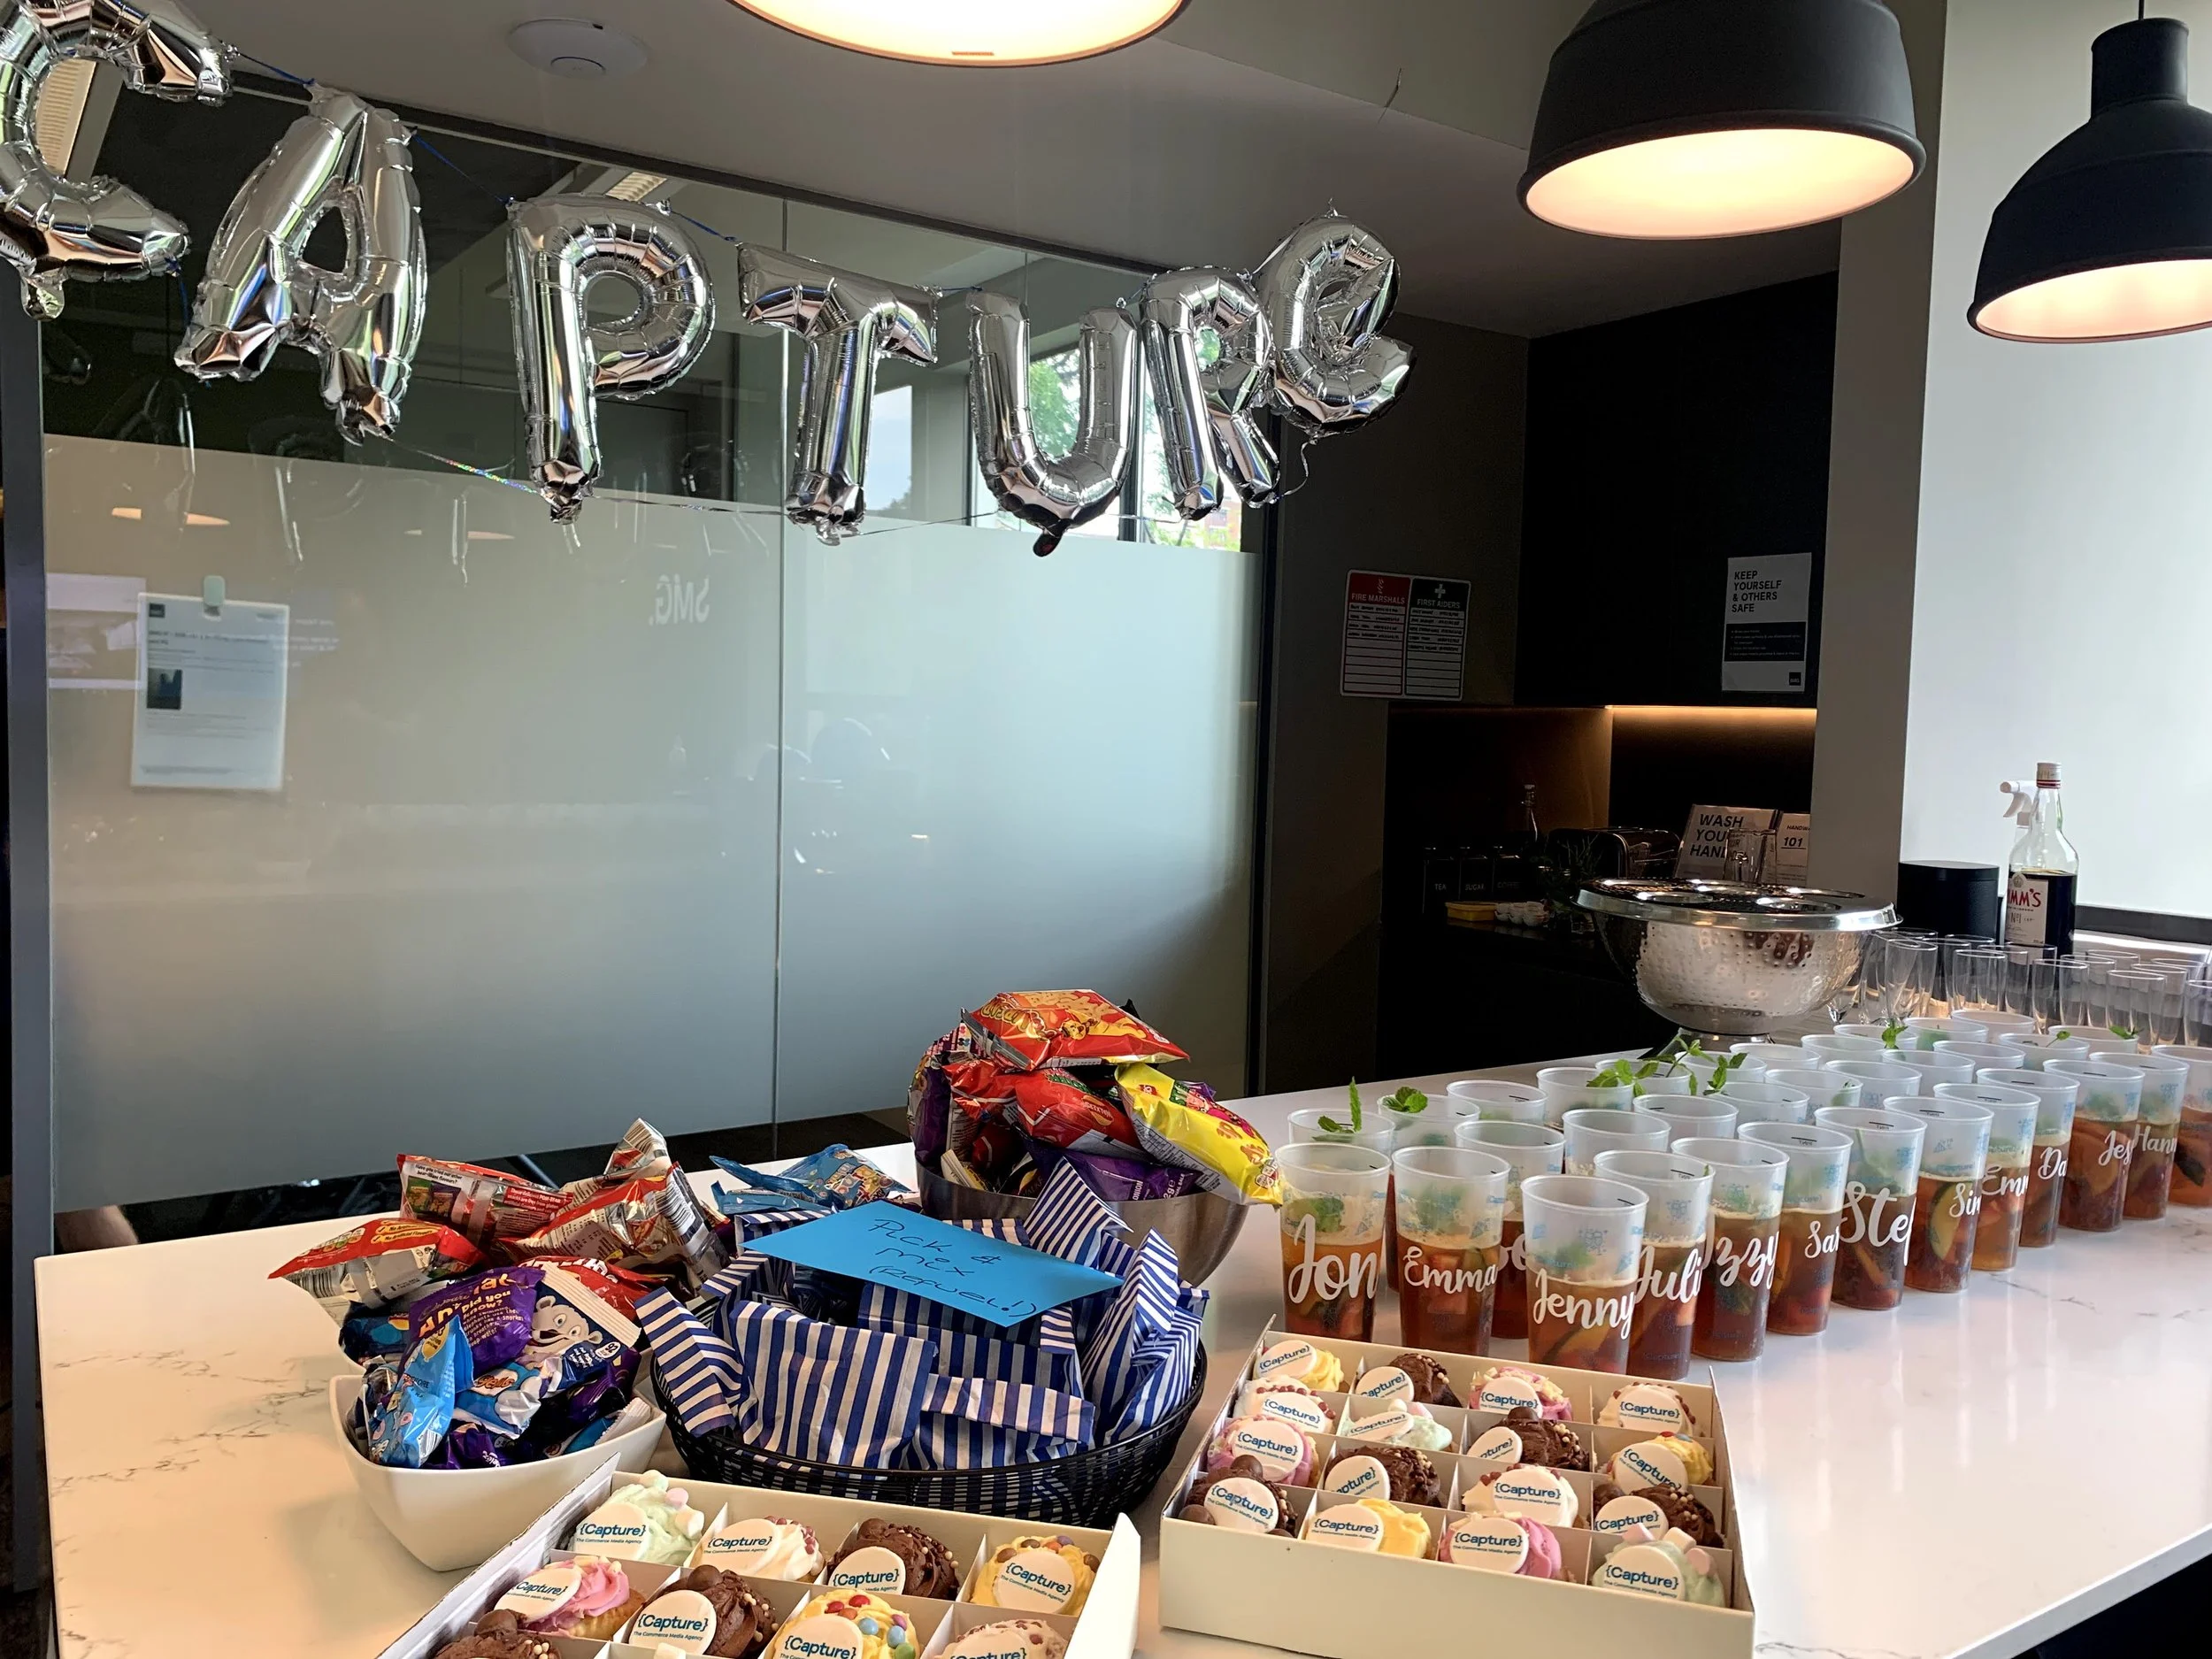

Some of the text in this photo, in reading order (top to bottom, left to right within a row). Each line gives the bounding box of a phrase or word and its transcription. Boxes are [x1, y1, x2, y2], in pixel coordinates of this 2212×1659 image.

[1734, 571, 1758, 580] KEEP
[1734, 580, 1782, 591] YOURSELF
[1351, 593, 1405, 604] FIRE MARSHALS
[1417, 598, 1435, 607] FIRST
[1741, 591, 1778, 602] OTHERS
[1732, 603, 1755, 612] SAFE
[1699, 814, 1743, 828] WASH
[1784, 837, 1803, 848] 101
[1288, 1213, 1378, 1303] Jon
[1403, 1246, 1497, 1294] Emma
[485, 1290, 511, 1302] you
[1532, 1268, 1637, 1340] Jenny
[1259, 1345, 1310, 1370] {Capture}
[1481, 1392, 1538, 1409] {Capture}
[1263, 1399, 1320, 1424] {Capture}
[1620, 1402, 1681, 1417] {Capture}
[1237, 1432, 1298, 1455] {Capture}
[1495, 1483, 1561, 1499] {Capture}
[1211, 1485, 1274, 1520] {Capture}
[579, 1523, 646, 1538] {Capture}
[1315, 1518, 1379, 1533] {Capture}
[708, 1536, 773, 1548] {Capture}
[1455, 1532, 1522, 1547] {Capture}
[832, 1569, 899, 1587] {Capture}
[1005, 1557, 1072, 1591] {Capture}
[1605, 1564, 1679, 1590] {Capture}
[637, 1614, 708, 1632] {Capture}
